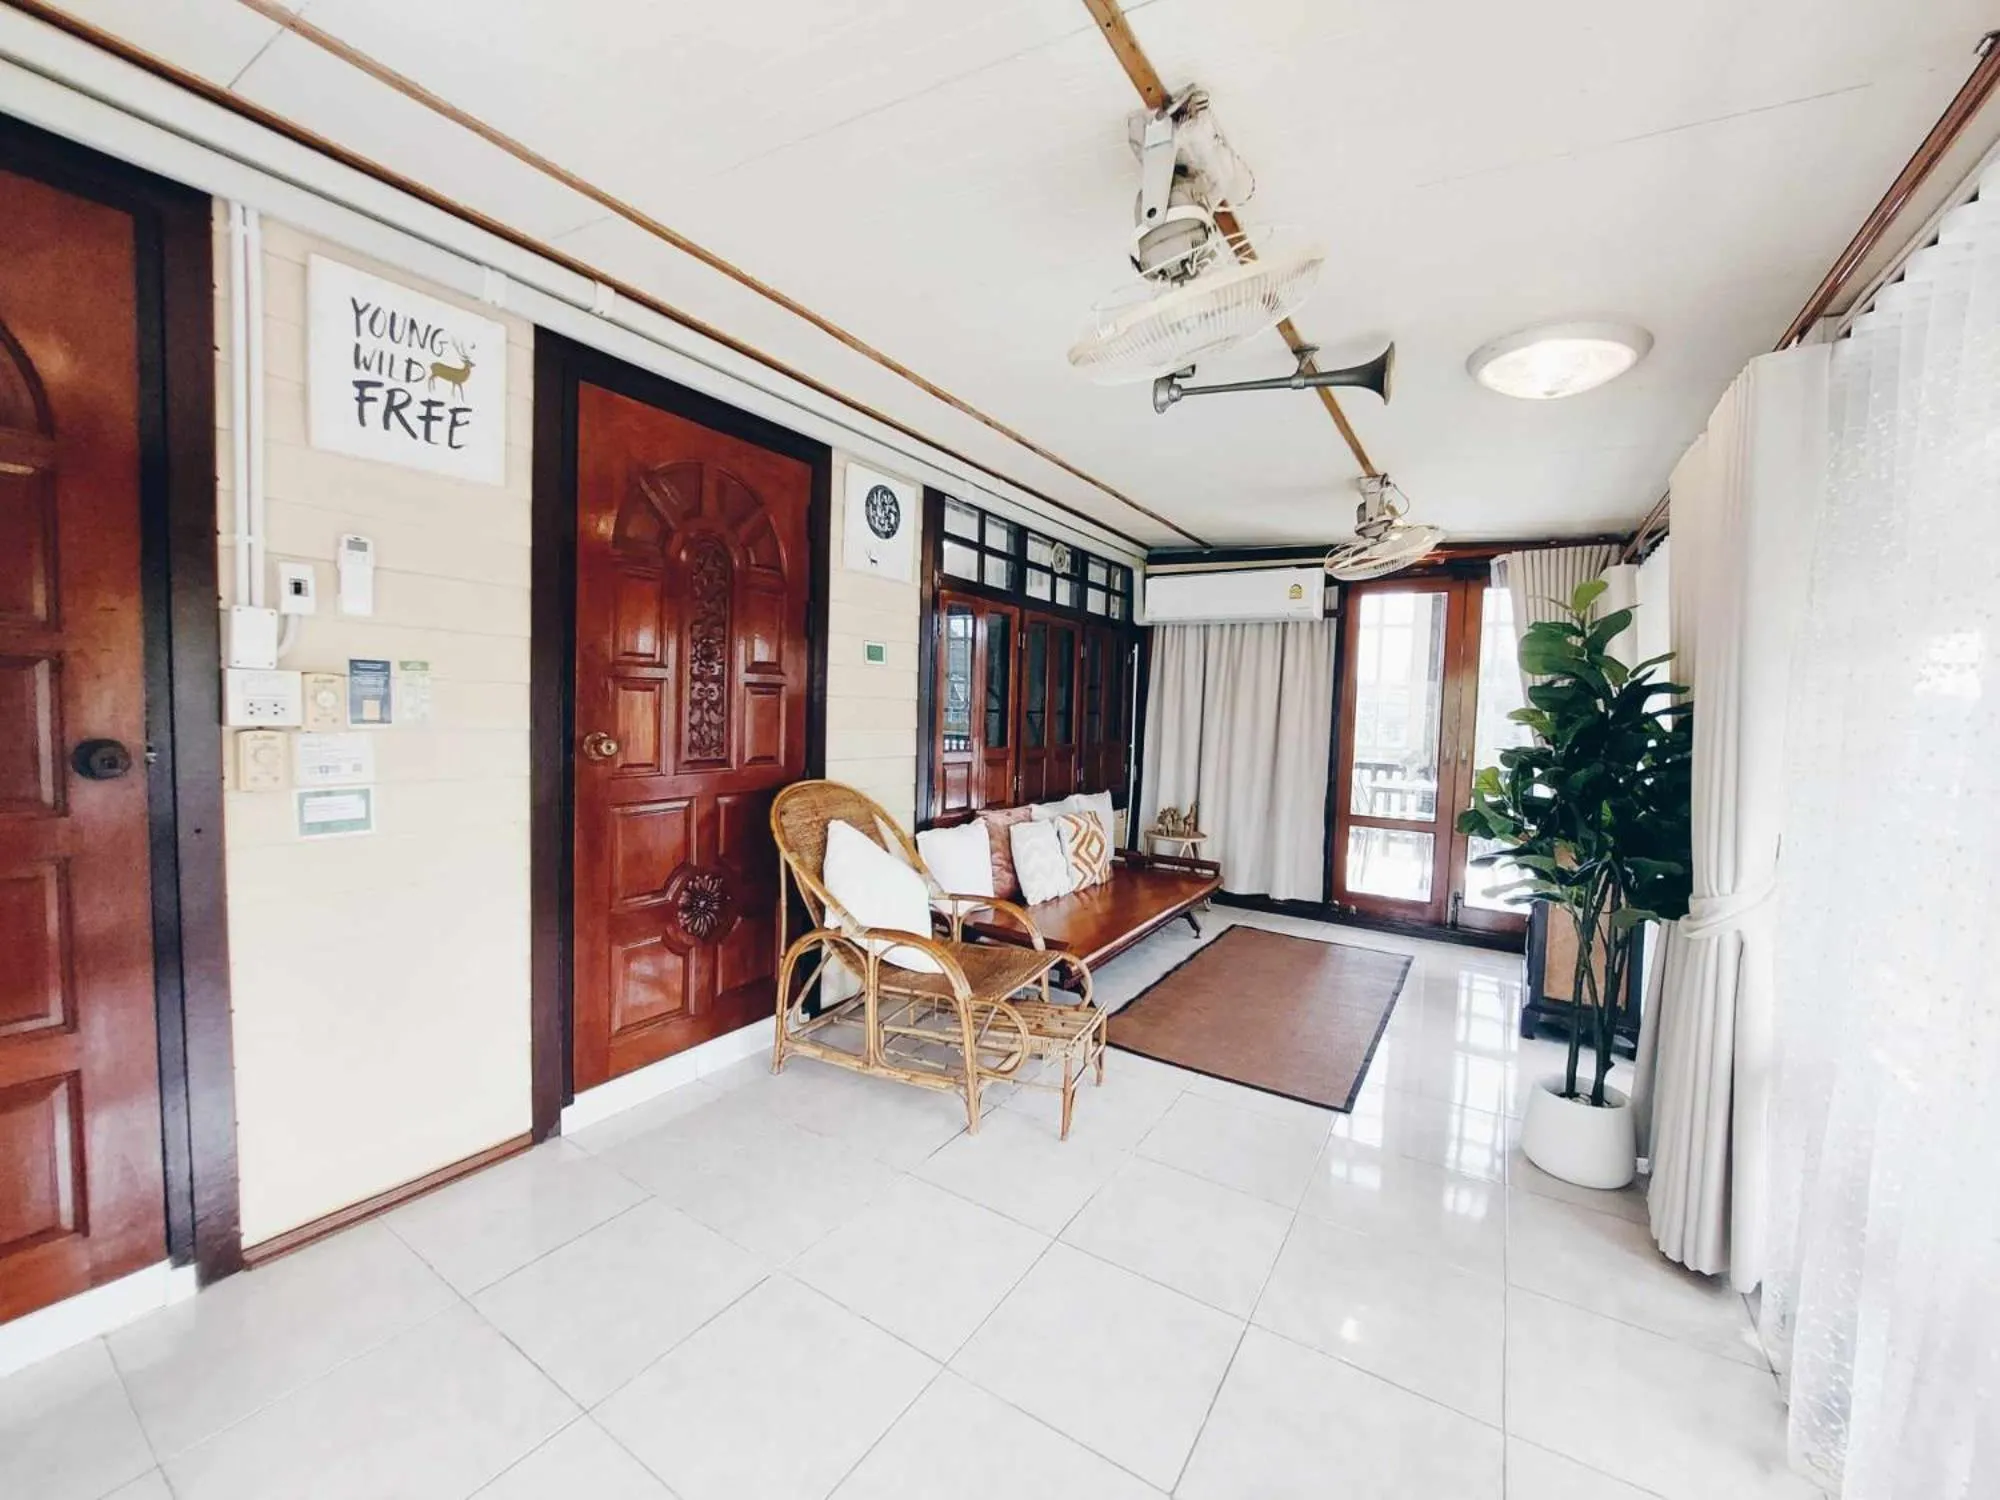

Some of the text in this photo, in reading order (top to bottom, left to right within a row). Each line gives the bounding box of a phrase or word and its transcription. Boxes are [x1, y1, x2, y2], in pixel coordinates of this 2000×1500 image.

[351, 297, 448, 357] YOUNG
[354, 342, 426, 383] WILD
[352, 380, 473, 449] FREE
